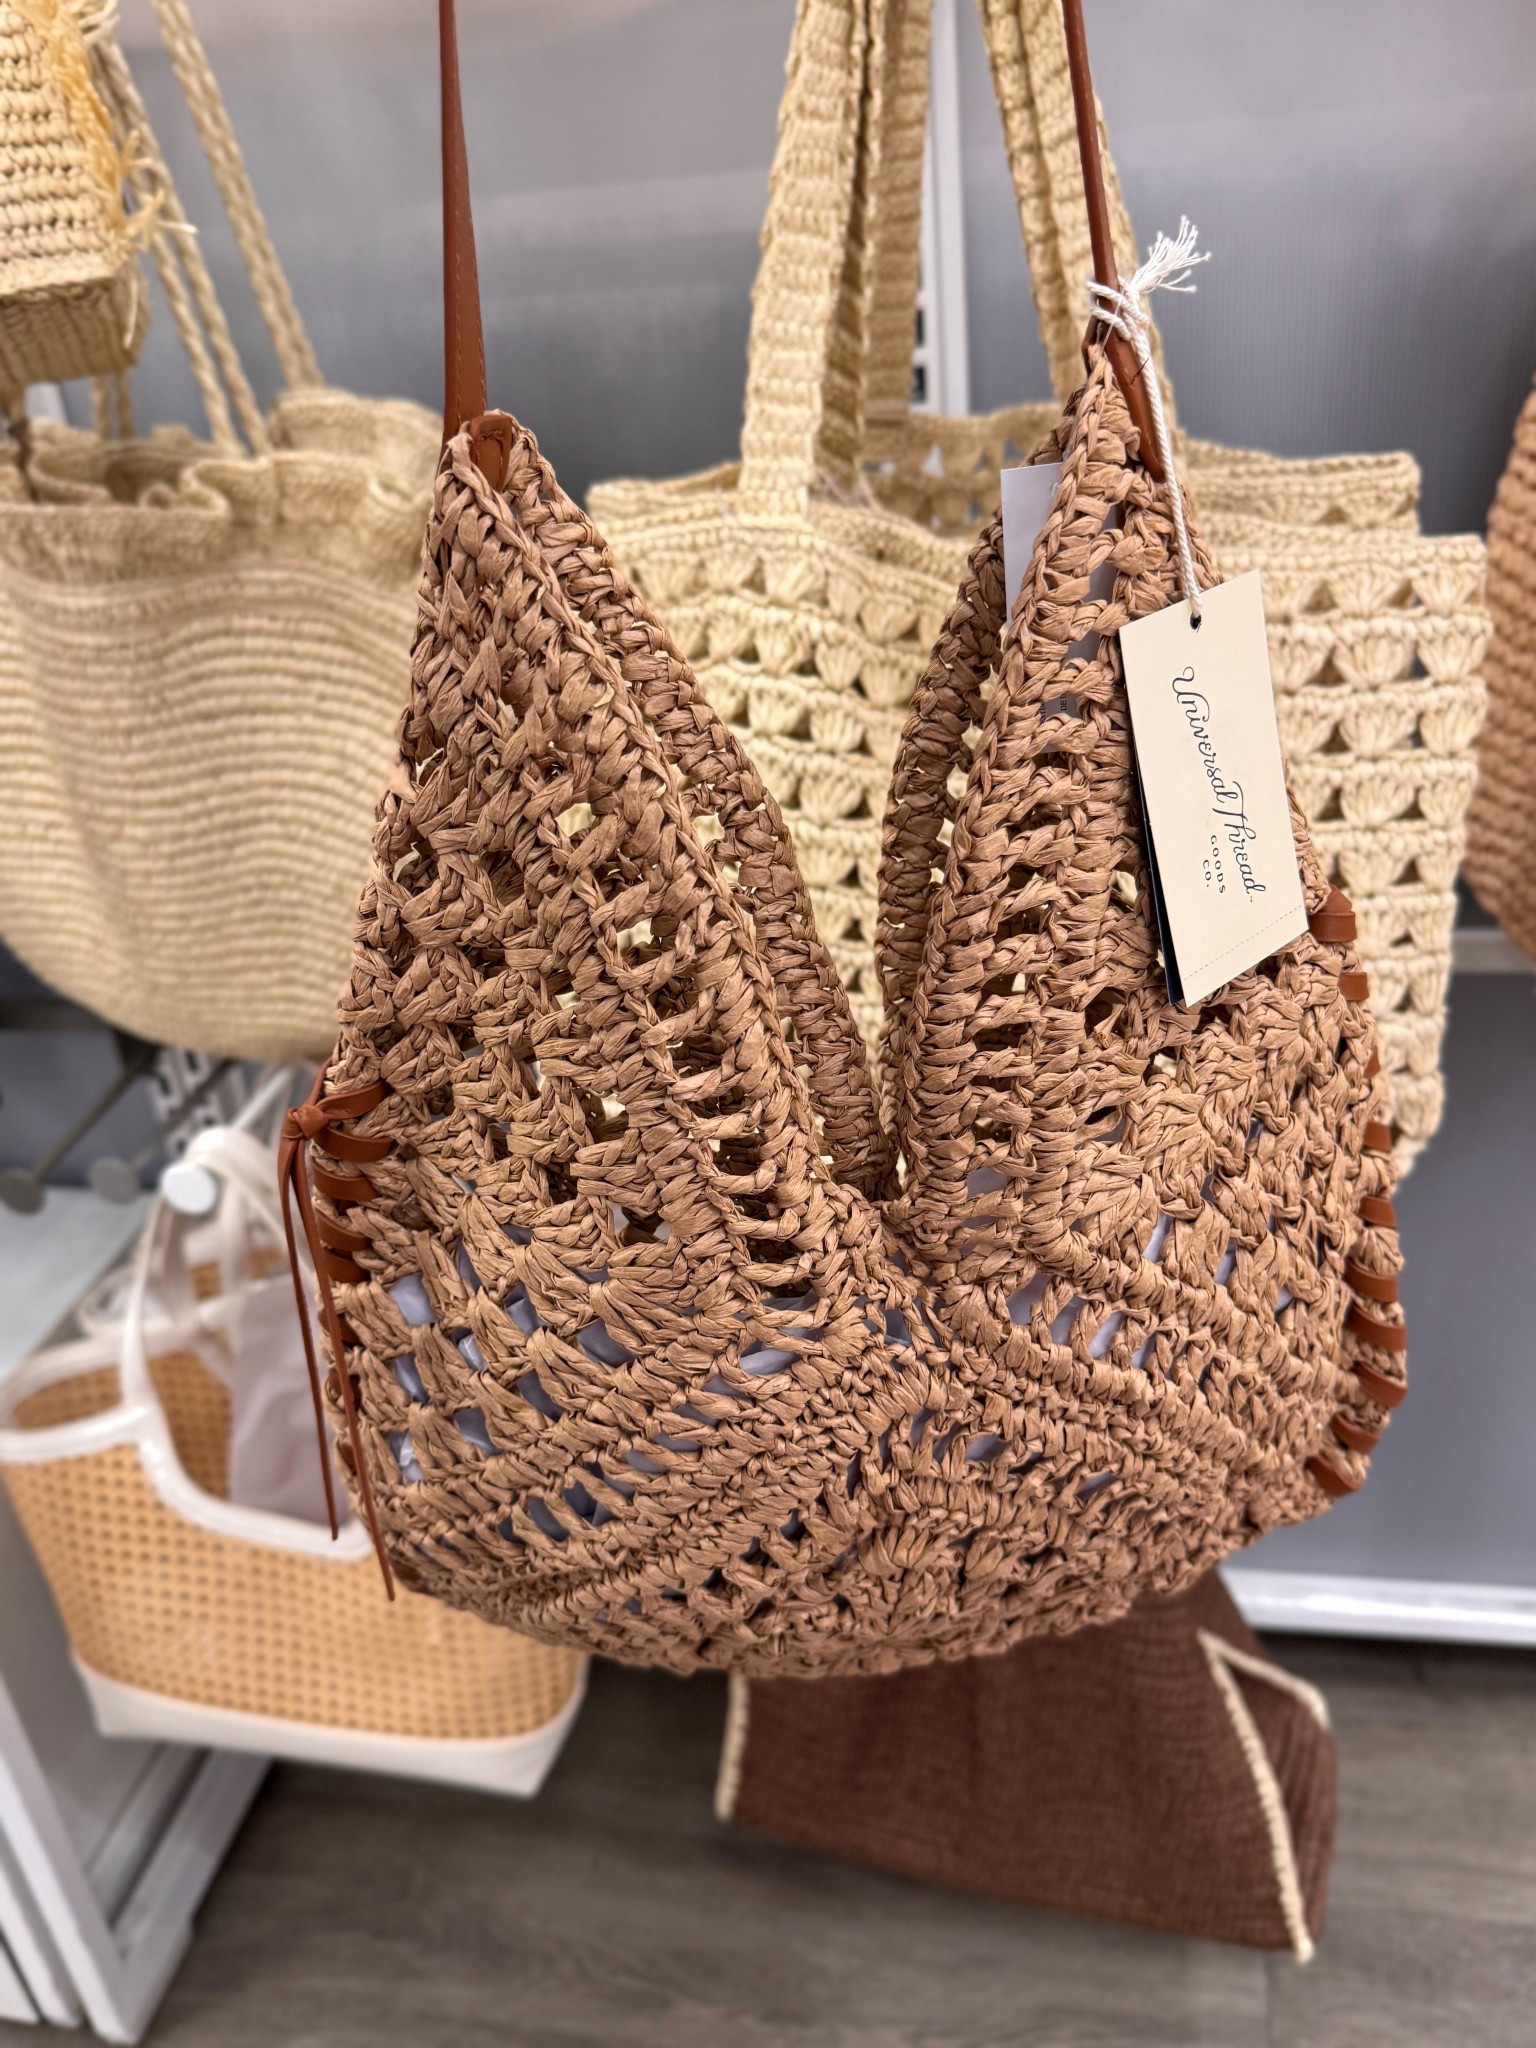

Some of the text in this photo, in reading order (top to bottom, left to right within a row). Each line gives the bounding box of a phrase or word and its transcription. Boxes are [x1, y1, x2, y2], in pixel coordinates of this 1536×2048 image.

[1171, 666, 1266, 895] Universal Thread
[1202, 859, 1212, 888] CO.
[1210, 834, 1226, 894] GOODS
